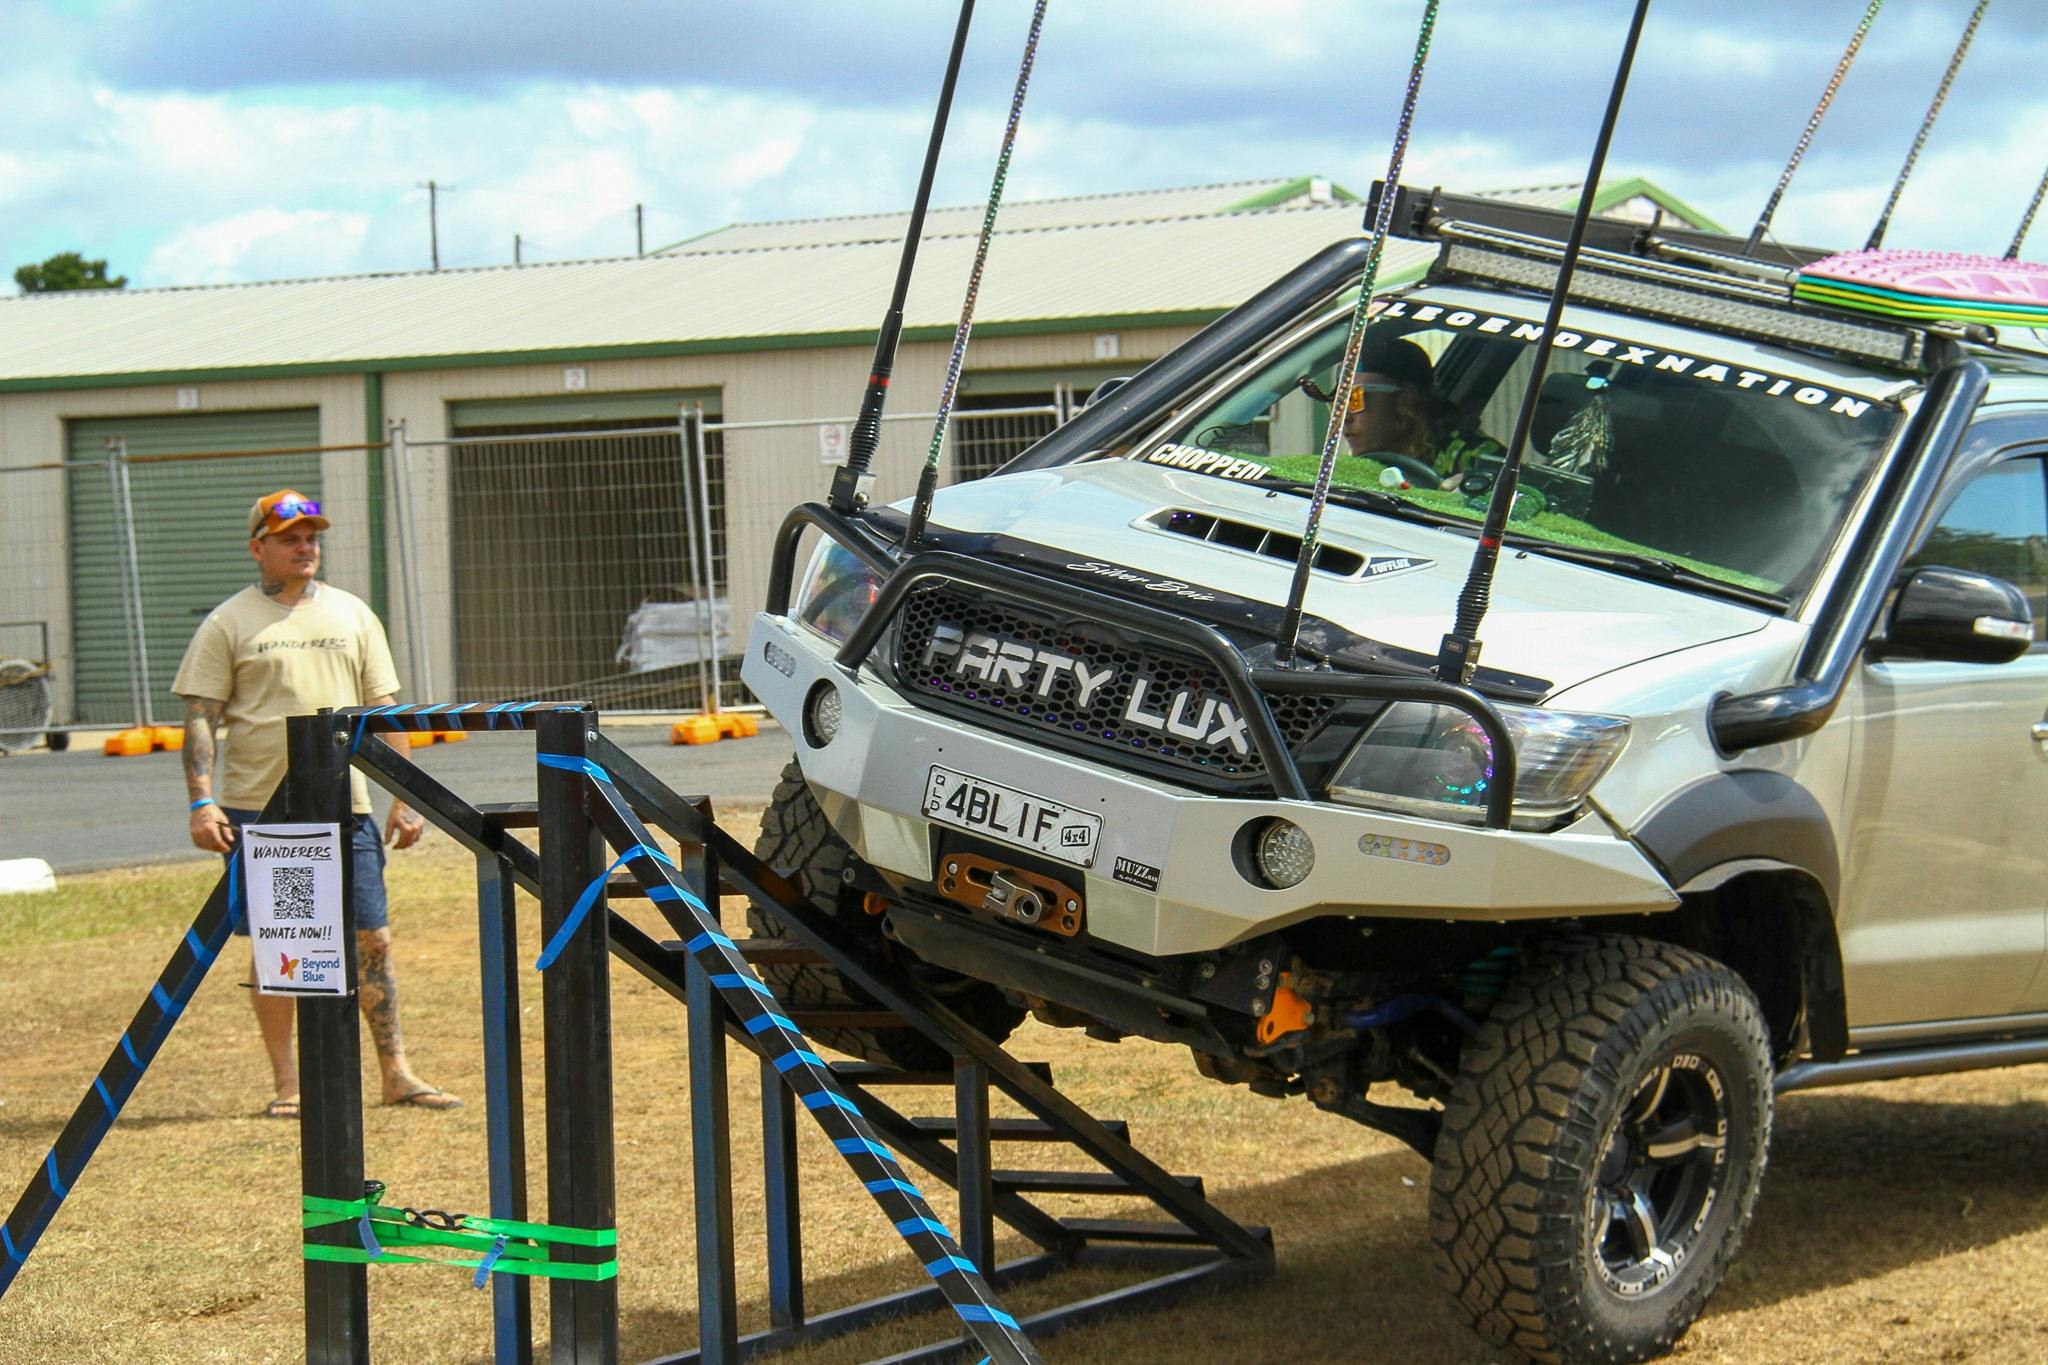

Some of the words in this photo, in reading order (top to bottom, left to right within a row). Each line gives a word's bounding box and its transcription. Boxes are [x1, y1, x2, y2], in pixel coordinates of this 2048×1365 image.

[921, 624, 1113, 708] PARTY
[1124, 678, 1249, 755] LUX
[930, 774, 946, 811] QLD
[945, 783, 1060, 843] 4BLIF
[1064, 827, 1087, 844] 4x4
[253, 844, 332, 860] WANDERERS
[259, 926, 297, 940] DONATE
[299, 925, 332, 941] NOW!!
[301, 957, 340, 973] Beyond
[302, 970, 326, 983] Blue
